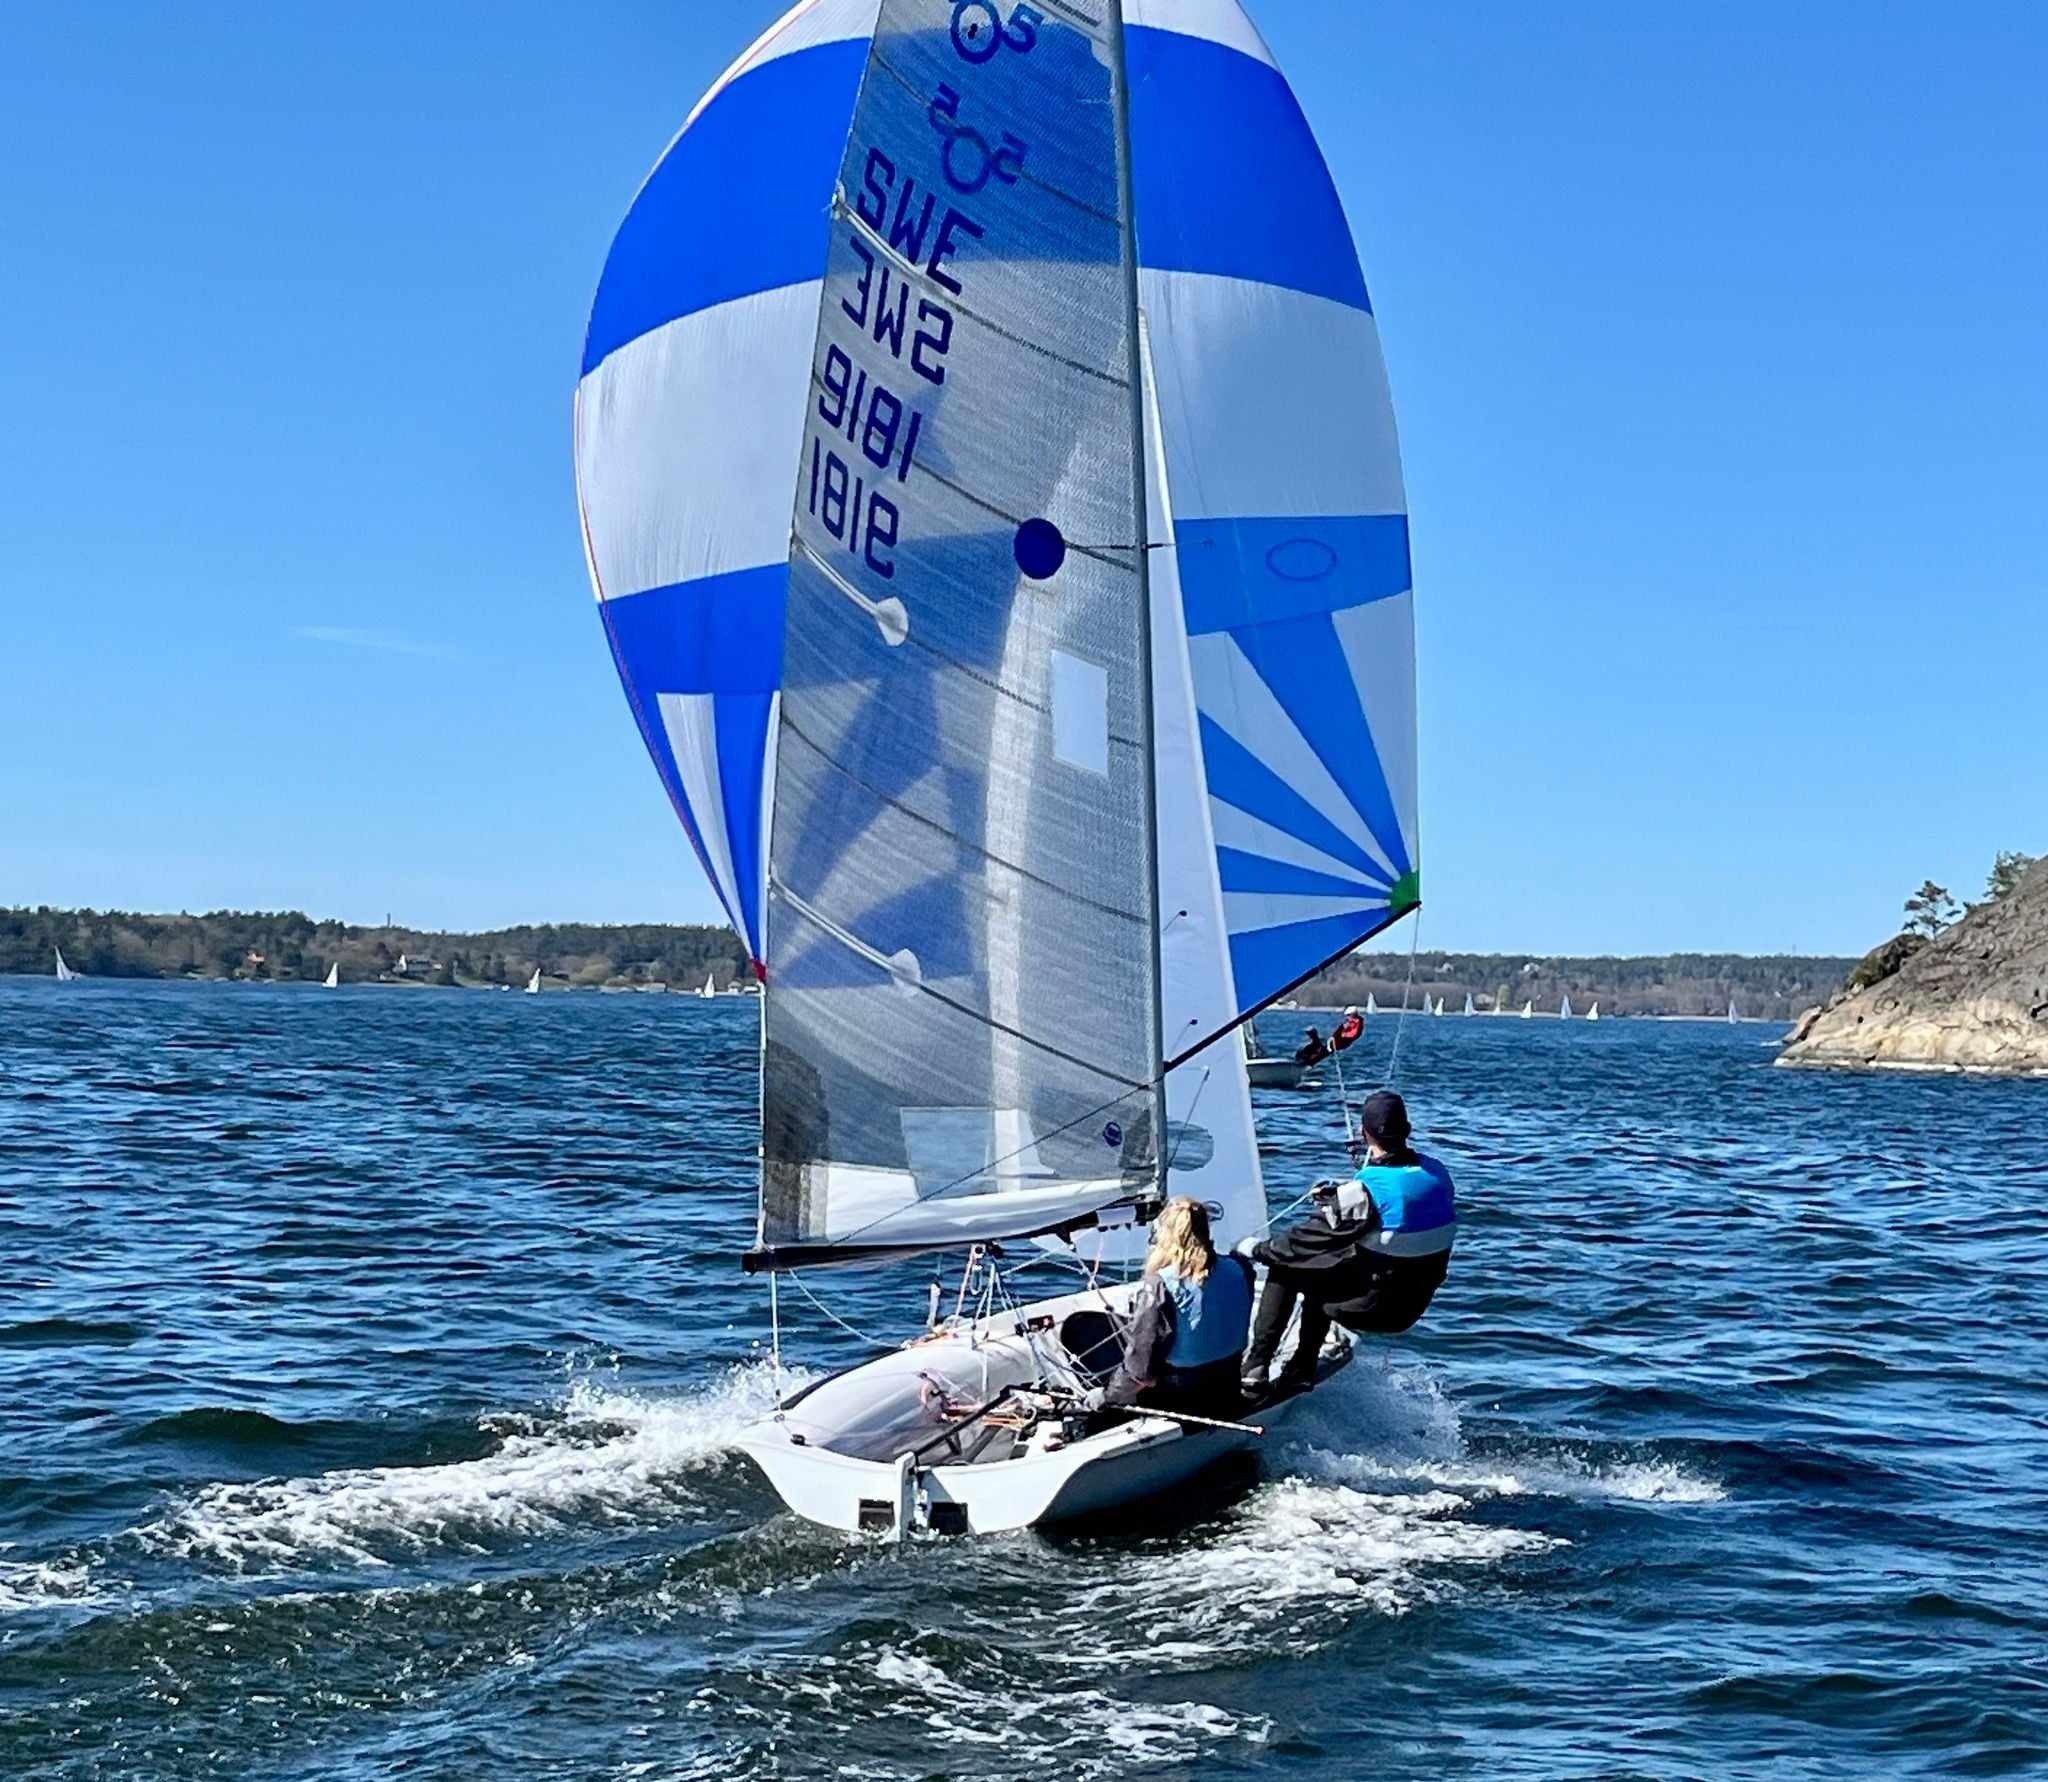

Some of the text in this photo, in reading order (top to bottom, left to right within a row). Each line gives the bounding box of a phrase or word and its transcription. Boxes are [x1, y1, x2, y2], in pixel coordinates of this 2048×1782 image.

[949, 0, 1045, 65] 05
[856, 147, 985, 297] SWE
[818, 343, 922, 484] 9181
